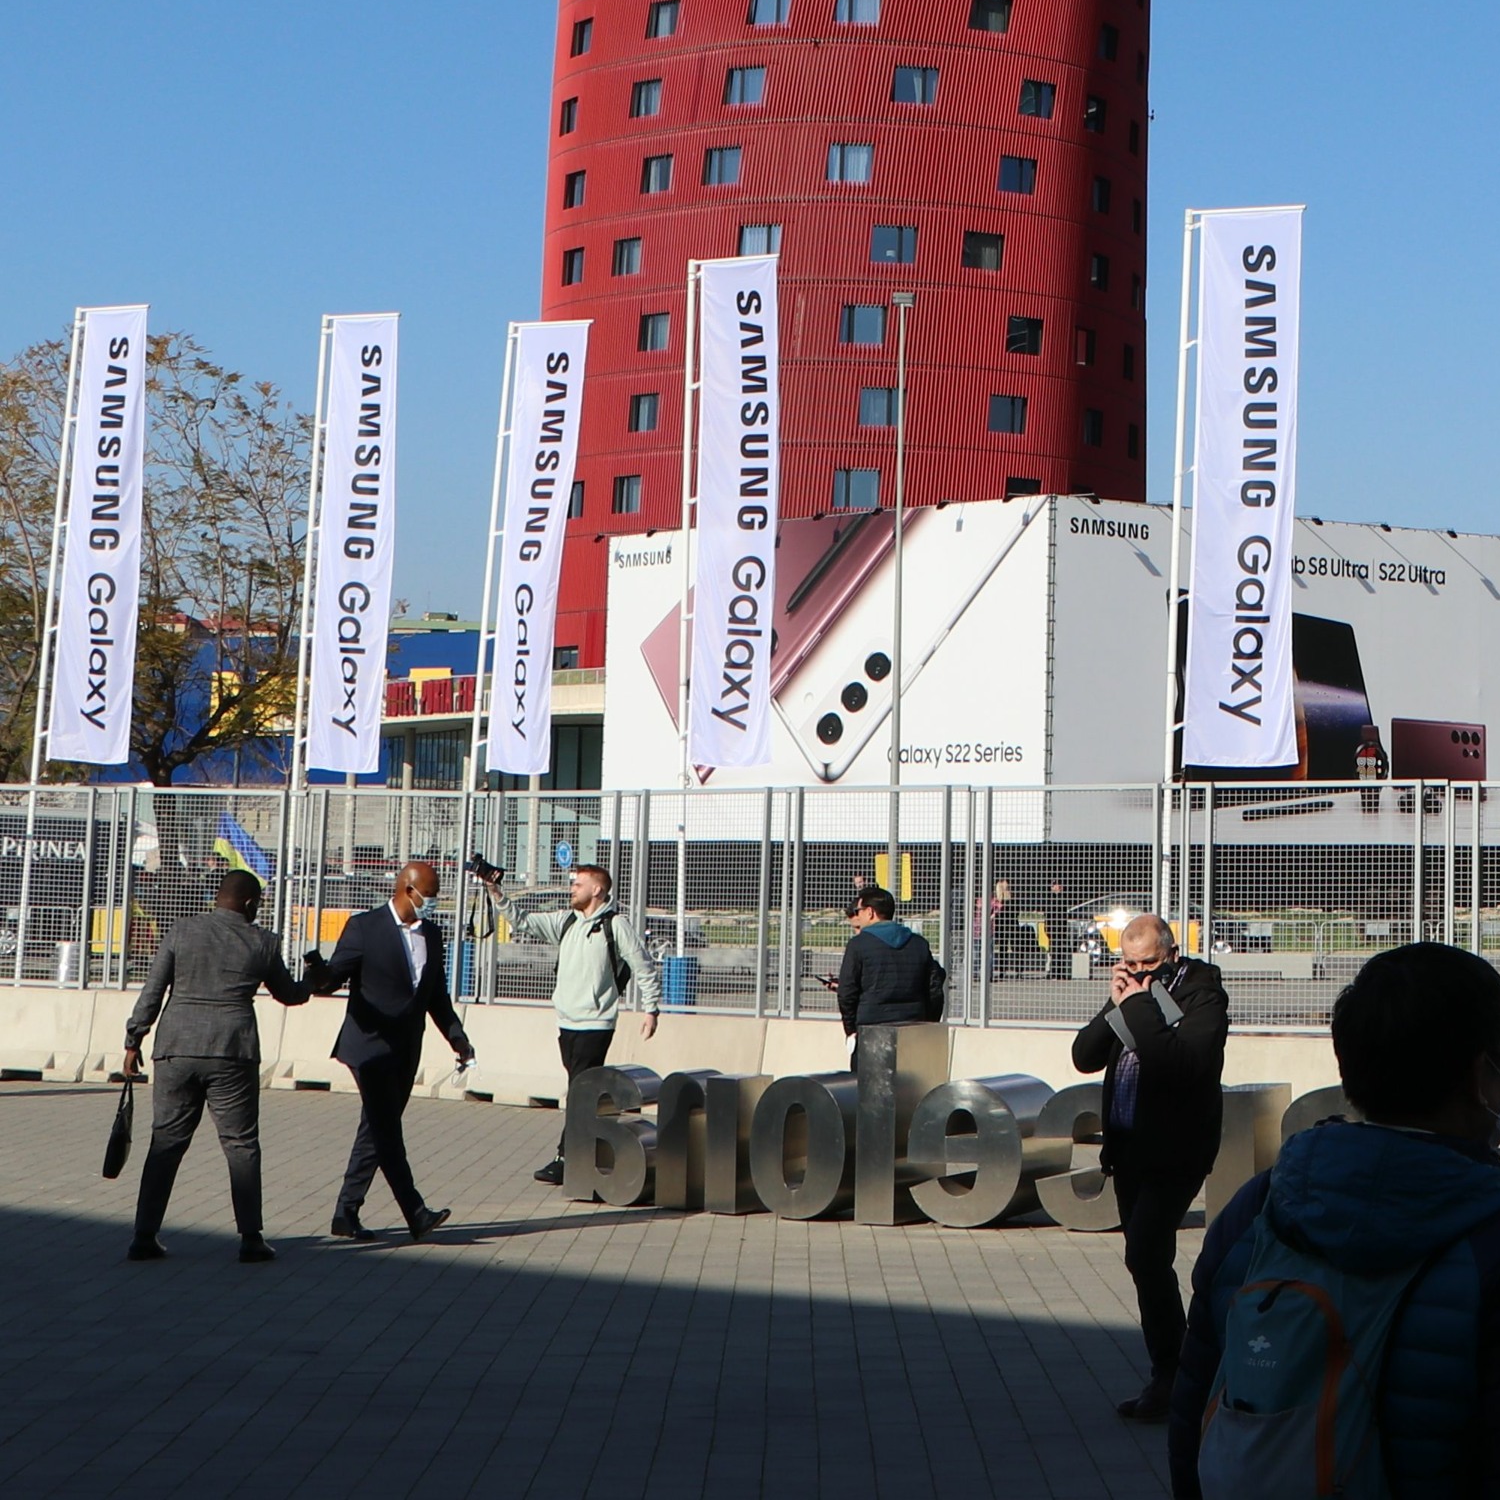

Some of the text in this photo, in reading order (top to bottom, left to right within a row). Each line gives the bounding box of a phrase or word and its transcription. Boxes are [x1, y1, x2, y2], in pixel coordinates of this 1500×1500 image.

[80, 336, 129, 730] SAMSUNG Galaxy
[331, 345, 383, 738] SAMSUNG Galaxy
[511, 352, 570, 739] SAMSUNG Galaxy
[618, 550, 672, 569] SAMSUNG
[711, 290, 769, 731] SAMSUNG Galaxy
[1070, 517, 1149, 540] SAMSUNG
[1218, 244, 1278, 726] SAMSUNG Galaxy
[1308, 557, 1328, 576] S8
[1330, 558, 1369, 580] Ultra
[1379, 562, 1446, 585] S22 Ultra
[945, 744, 971, 764] S22
[974, 741, 1023, 762] Series
